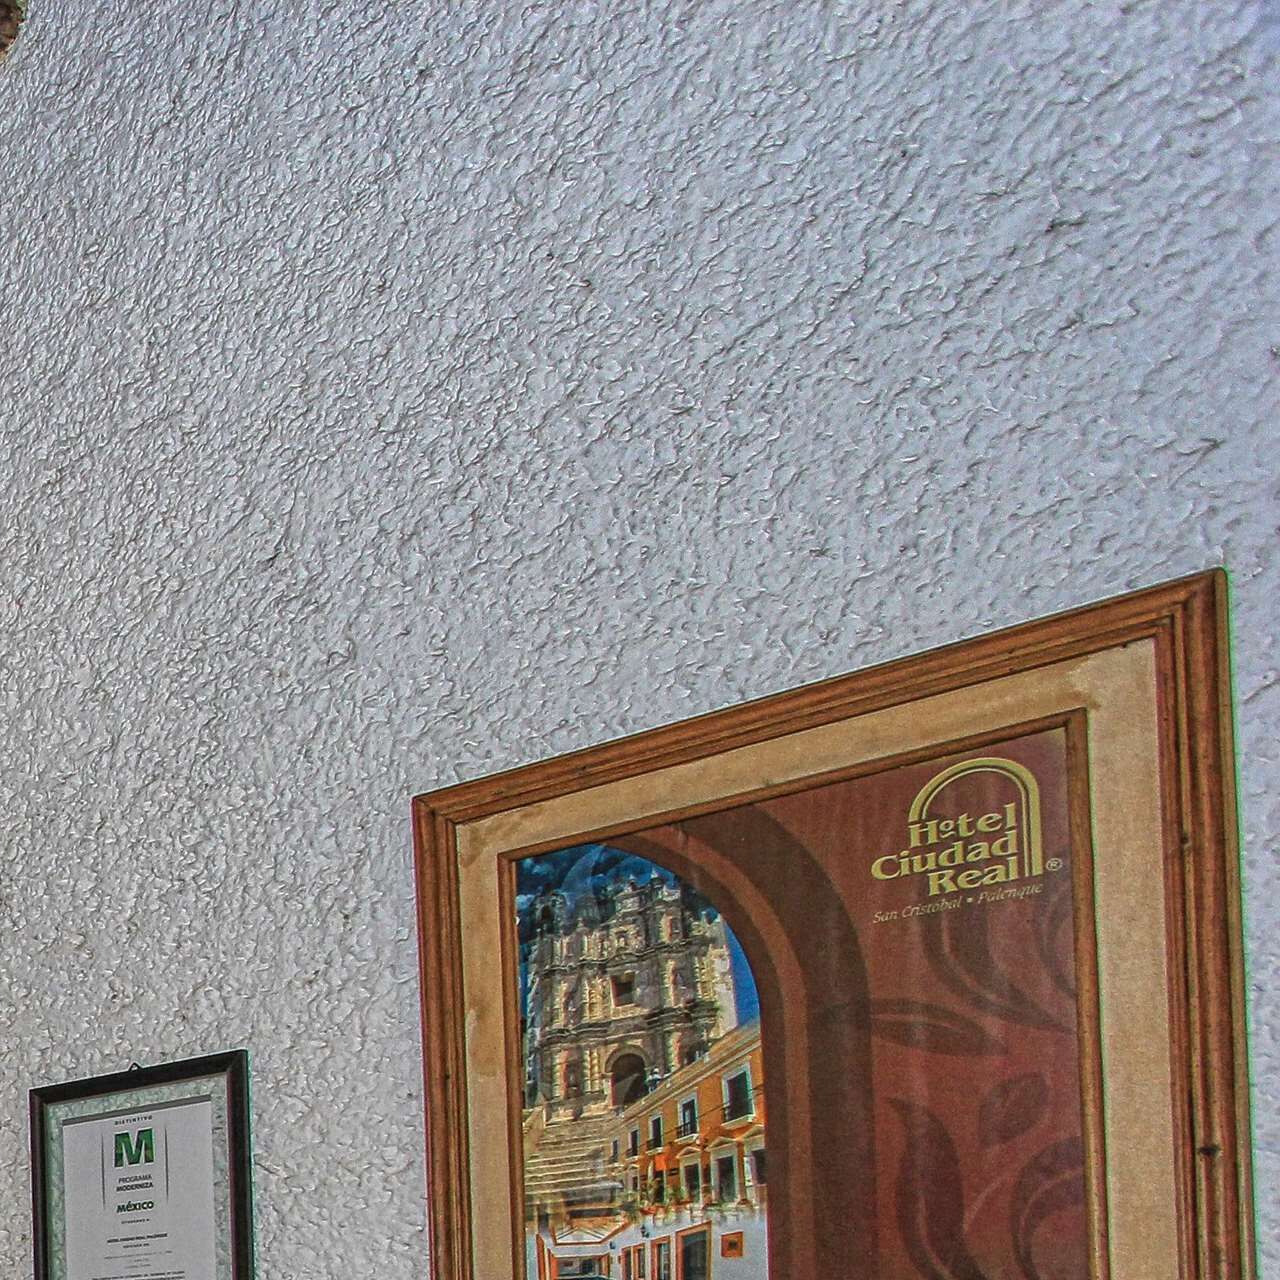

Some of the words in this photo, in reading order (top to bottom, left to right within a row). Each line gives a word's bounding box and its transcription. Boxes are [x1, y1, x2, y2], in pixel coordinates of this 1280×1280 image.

[908, 803, 1016, 848] Hotel
[871, 830, 1018, 880] Ciudad
[928, 856, 1018, 896] Real
[873, 911, 898, 924] San
[978, 882, 1044, 904] Palenque
[114, 1127, 155, 1168] M
[116, 1182, 154, 1193] MODERNIZA
[119, 1173, 153, 1184] PROGRAMA
